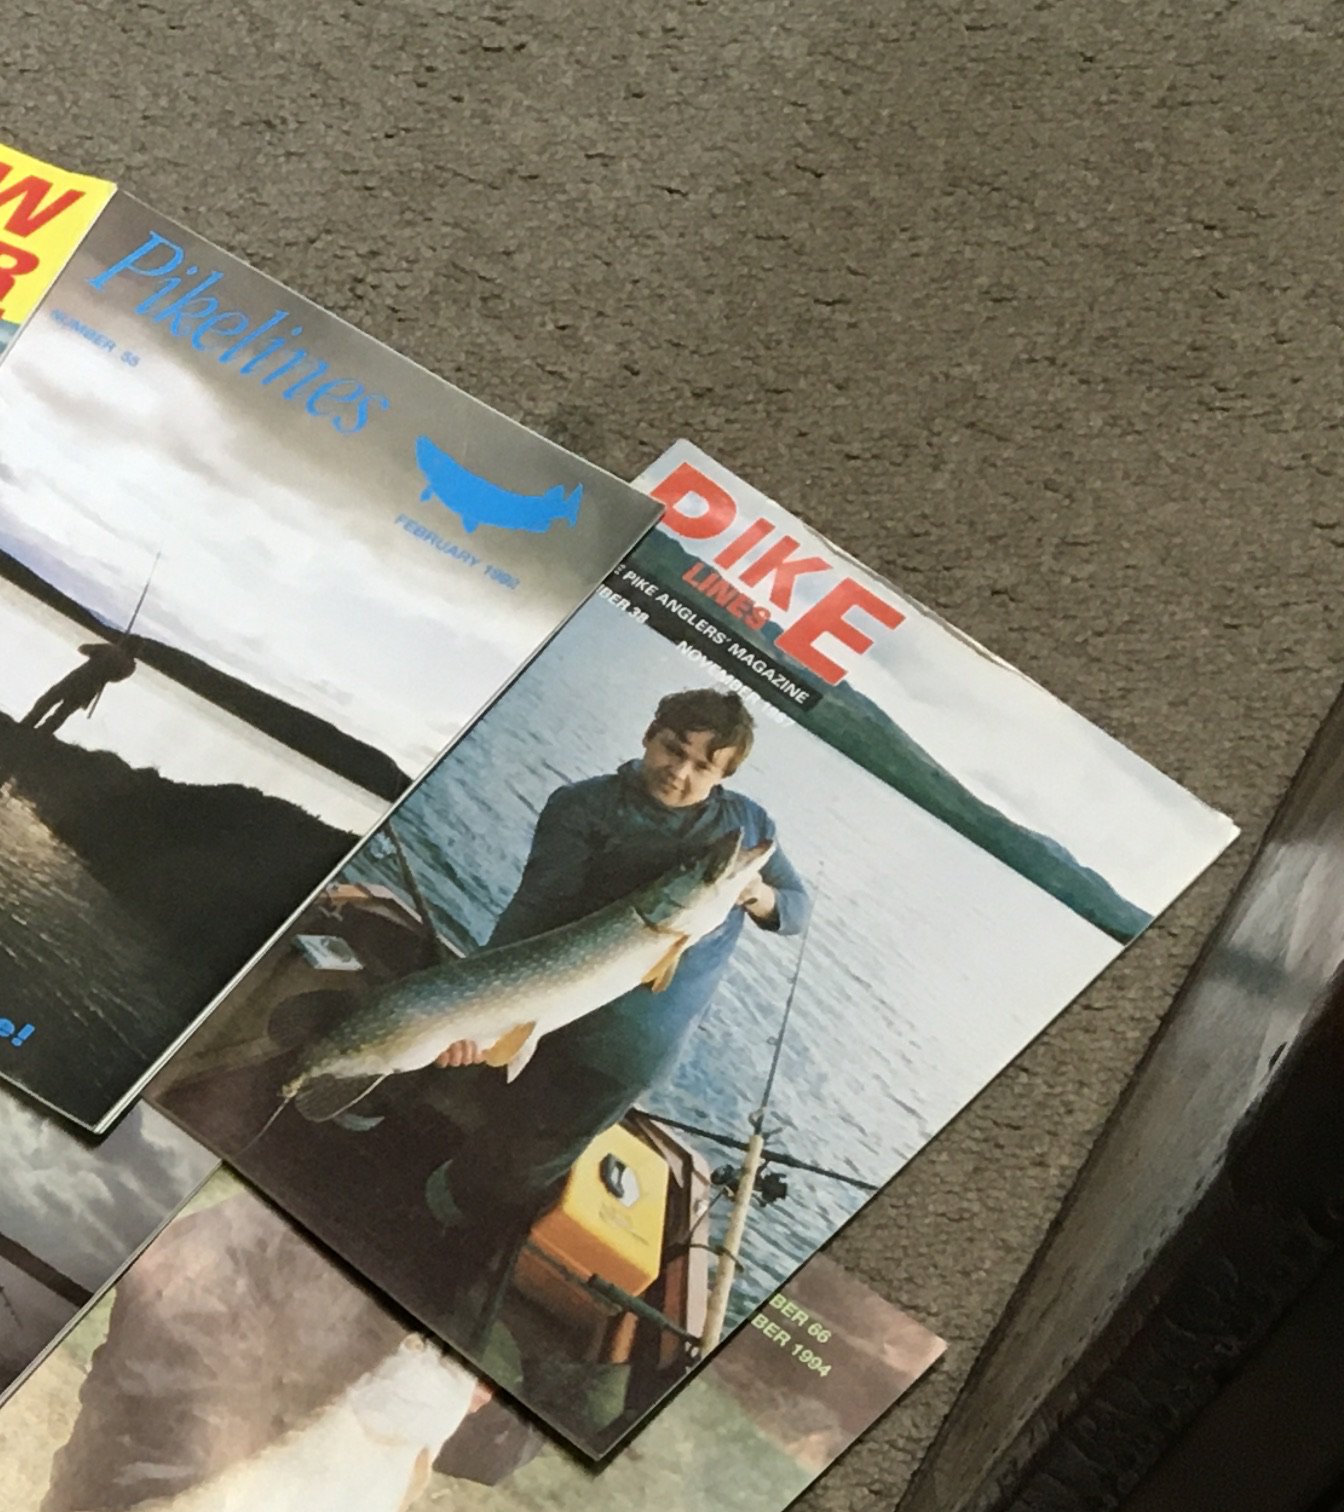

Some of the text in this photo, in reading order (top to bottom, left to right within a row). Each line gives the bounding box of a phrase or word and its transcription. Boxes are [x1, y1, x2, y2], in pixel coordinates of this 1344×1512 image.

[85, 230, 390, 434] Pikelines
[394, 513, 480, 567] FEBRUARY
[596, 583, 631, 611] BER
[648, 461, 906, 687] PIKE
[681, 562, 772, 631] LINES
[622, 570, 811, 705] PIKE ANGLERS' MAGAZINE
[675, 639, 763, 703] NOVEMBER
[791, 1343, 832, 1378] 1994
[807, 1322, 832, 1343] 66
